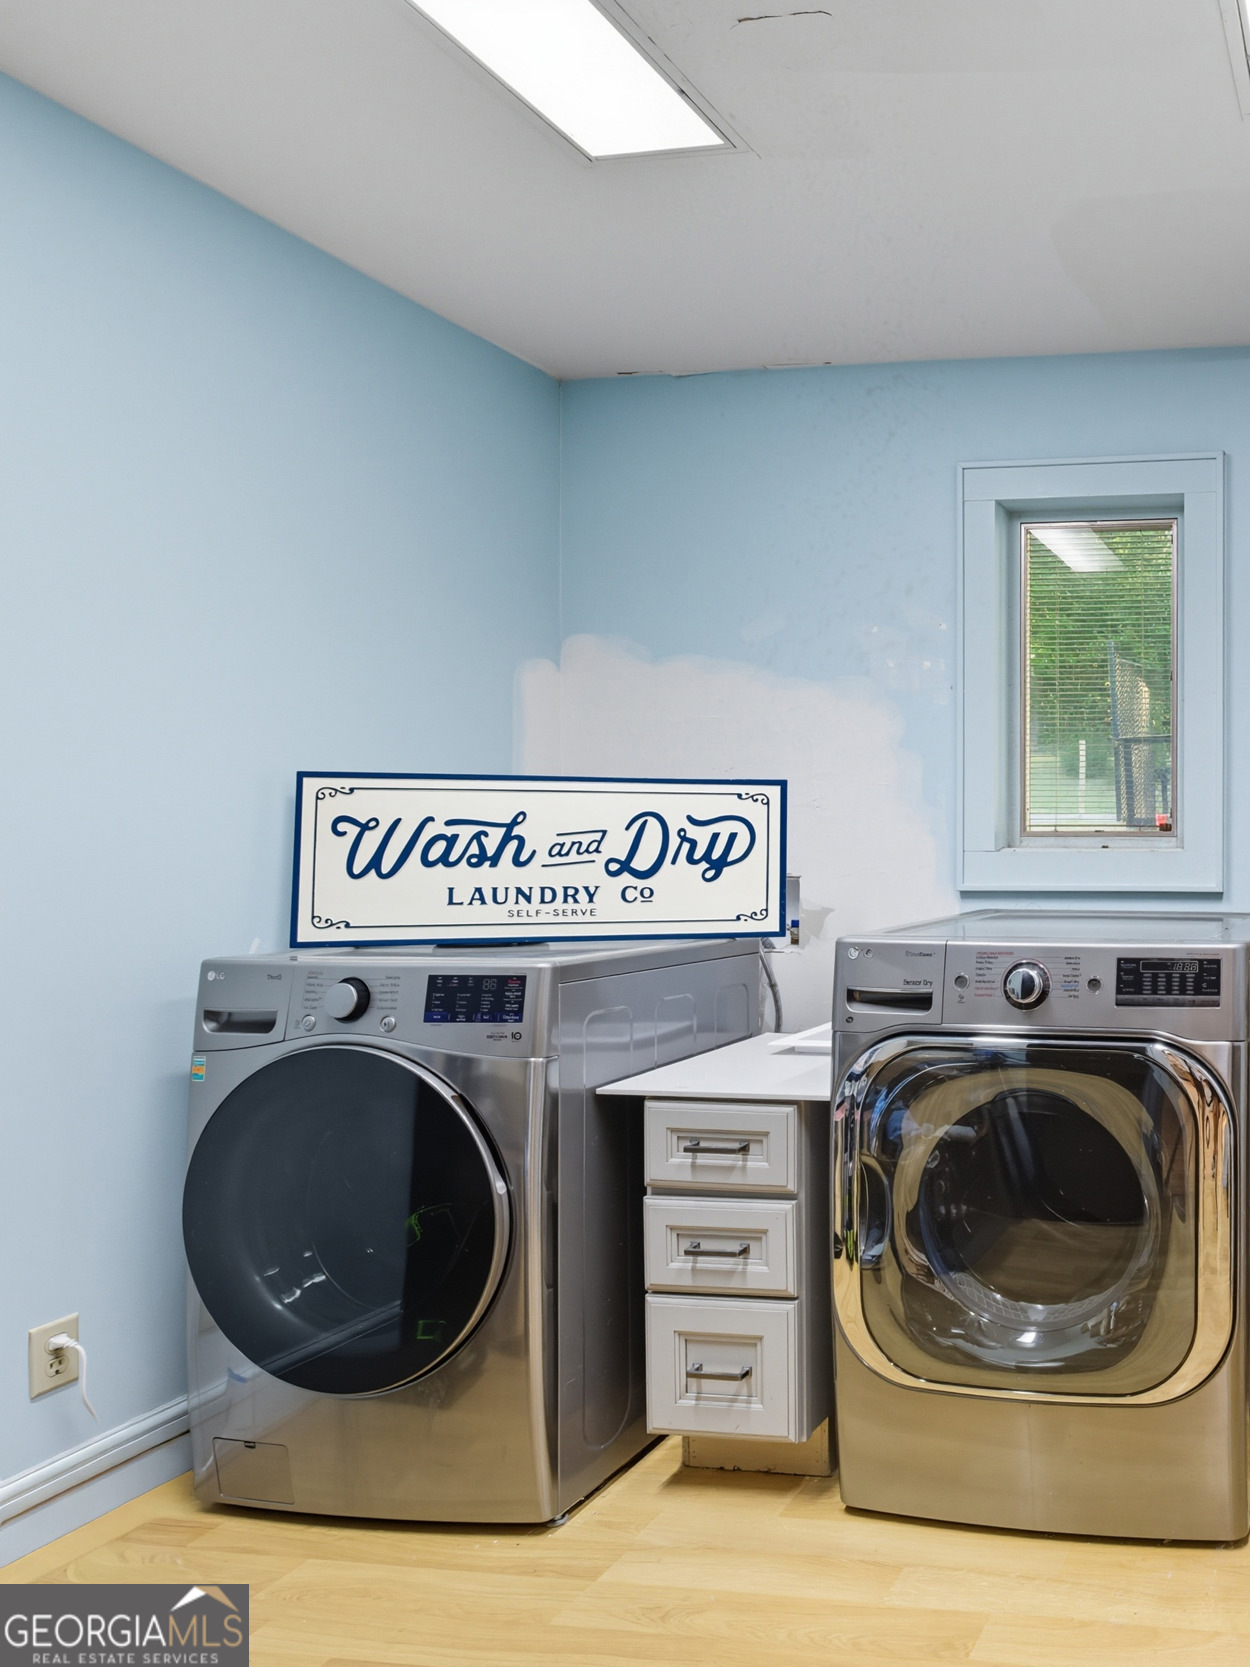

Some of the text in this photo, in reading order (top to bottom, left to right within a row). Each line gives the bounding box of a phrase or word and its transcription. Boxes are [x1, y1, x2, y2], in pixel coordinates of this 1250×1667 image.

[331, 810, 756, 883] Wash and Dry
[446, 885, 655, 906] LAUNDRY Co
[507, 908, 597, 918] SELF-SERVE
